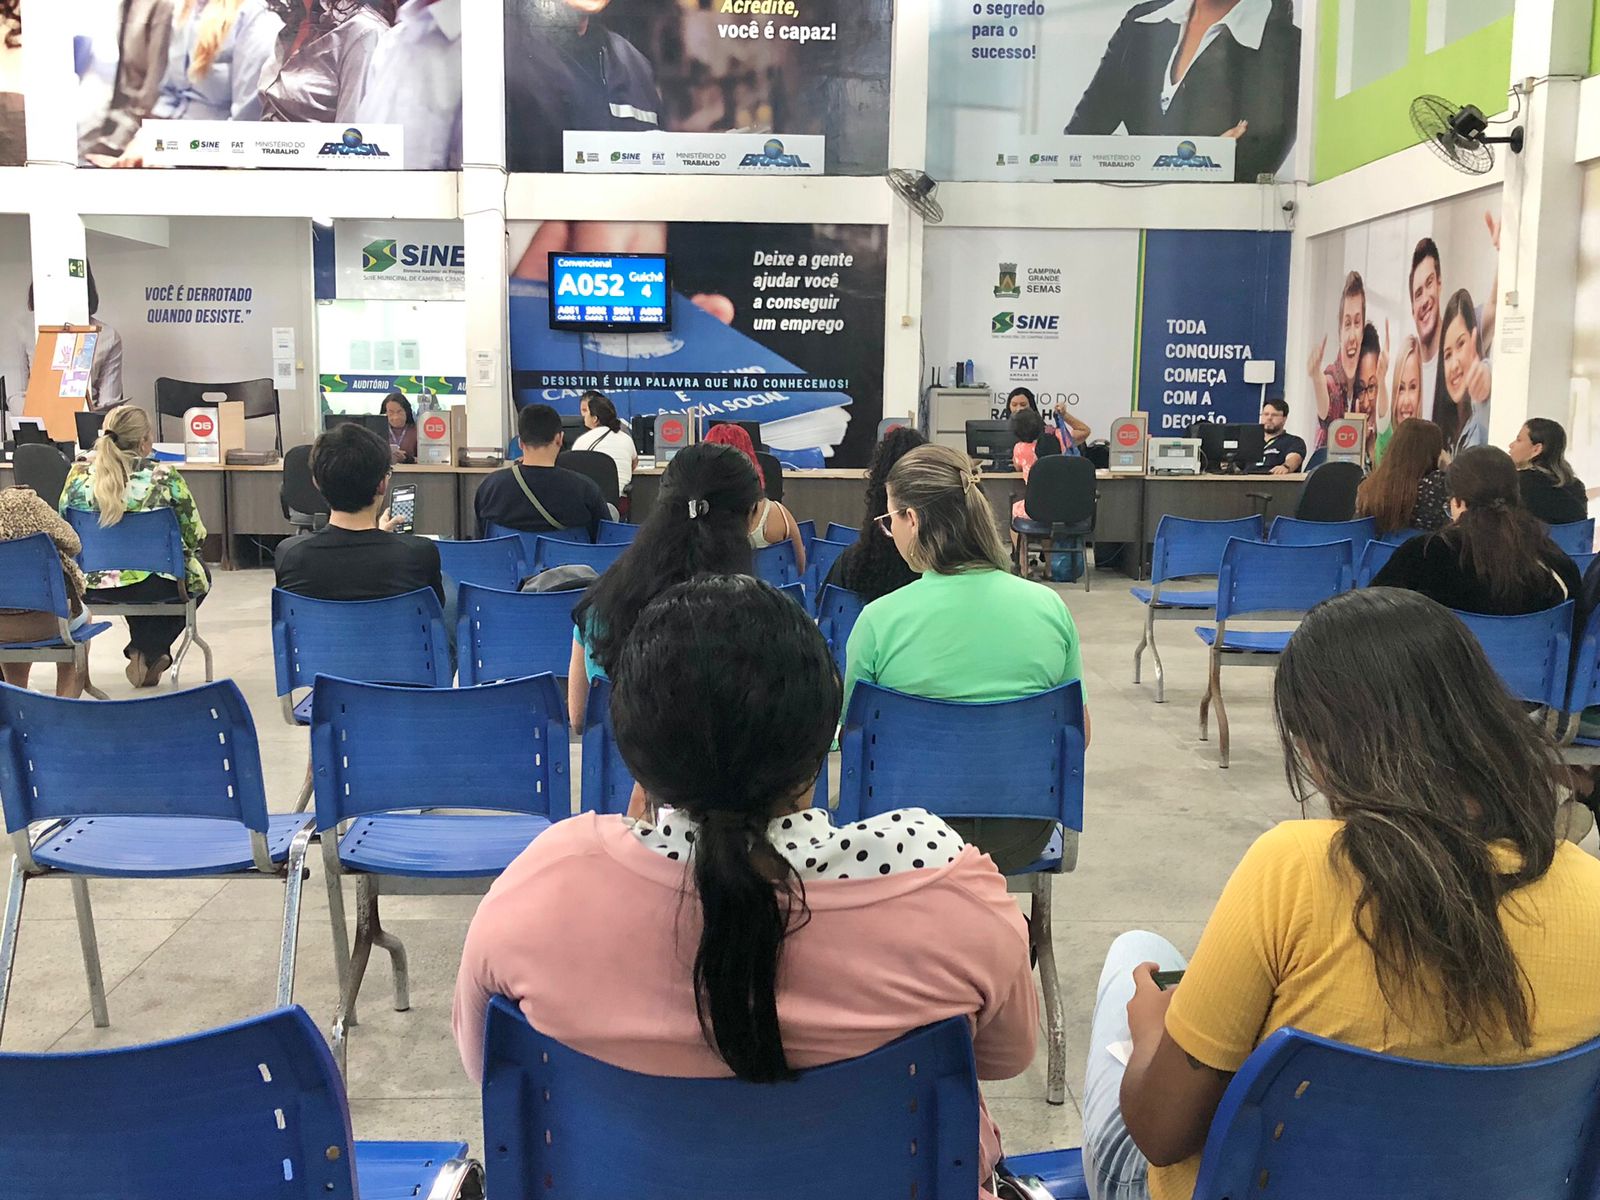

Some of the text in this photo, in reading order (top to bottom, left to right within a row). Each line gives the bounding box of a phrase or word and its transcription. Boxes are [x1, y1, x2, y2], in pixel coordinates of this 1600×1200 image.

[720, 0, 800, 18] Acredite,
[973, 0, 1045, 19] o segredo
[718, 20, 837, 44] você é capaz!
[972, 25, 1018, 40] para o
[971, 45, 1036, 59] sucesso!
[255, 141, 293, 149] MINISTÉRIO
[676, 152, 714, 160] MINISTÉRIO
[557, 258, 612, 268] Convencional
[753, 250, 854, 270] Deixe a gente
[557, 273, 625, 297] A052
[753, 272, 839, 291] ajudar você
[145, 284, 252, 301] VOCÊ É DERROTADO
[641, 284, 653, 298] 4
[1027, 285, 1061, 294] SEMAS
[753, 293, 840, 313] a conseguir
[147, 309, 193, 323] QUANDO
[753, 318, 844, 335] um emprego
[1166, 319, 1207, 335] TODA
[1165, 343, 1252, 360] CONQUISTA
[1010, 356, 1039, 370] FAT
[352, 378, 390, 390] AUDITÓRIO
[542, 374, 849, 389] DESISTIR É UMA PALAVRA QUE NÃO CONHECEMOS!
[1164, 368, 1227, 387] COMEÇA
[722, 390, 790, 411] SOCIAL
[1163, 390, 1212, 405] COM A
[192, 421, 212, 430] 06
[1338, 432, 1354, 441] 01
